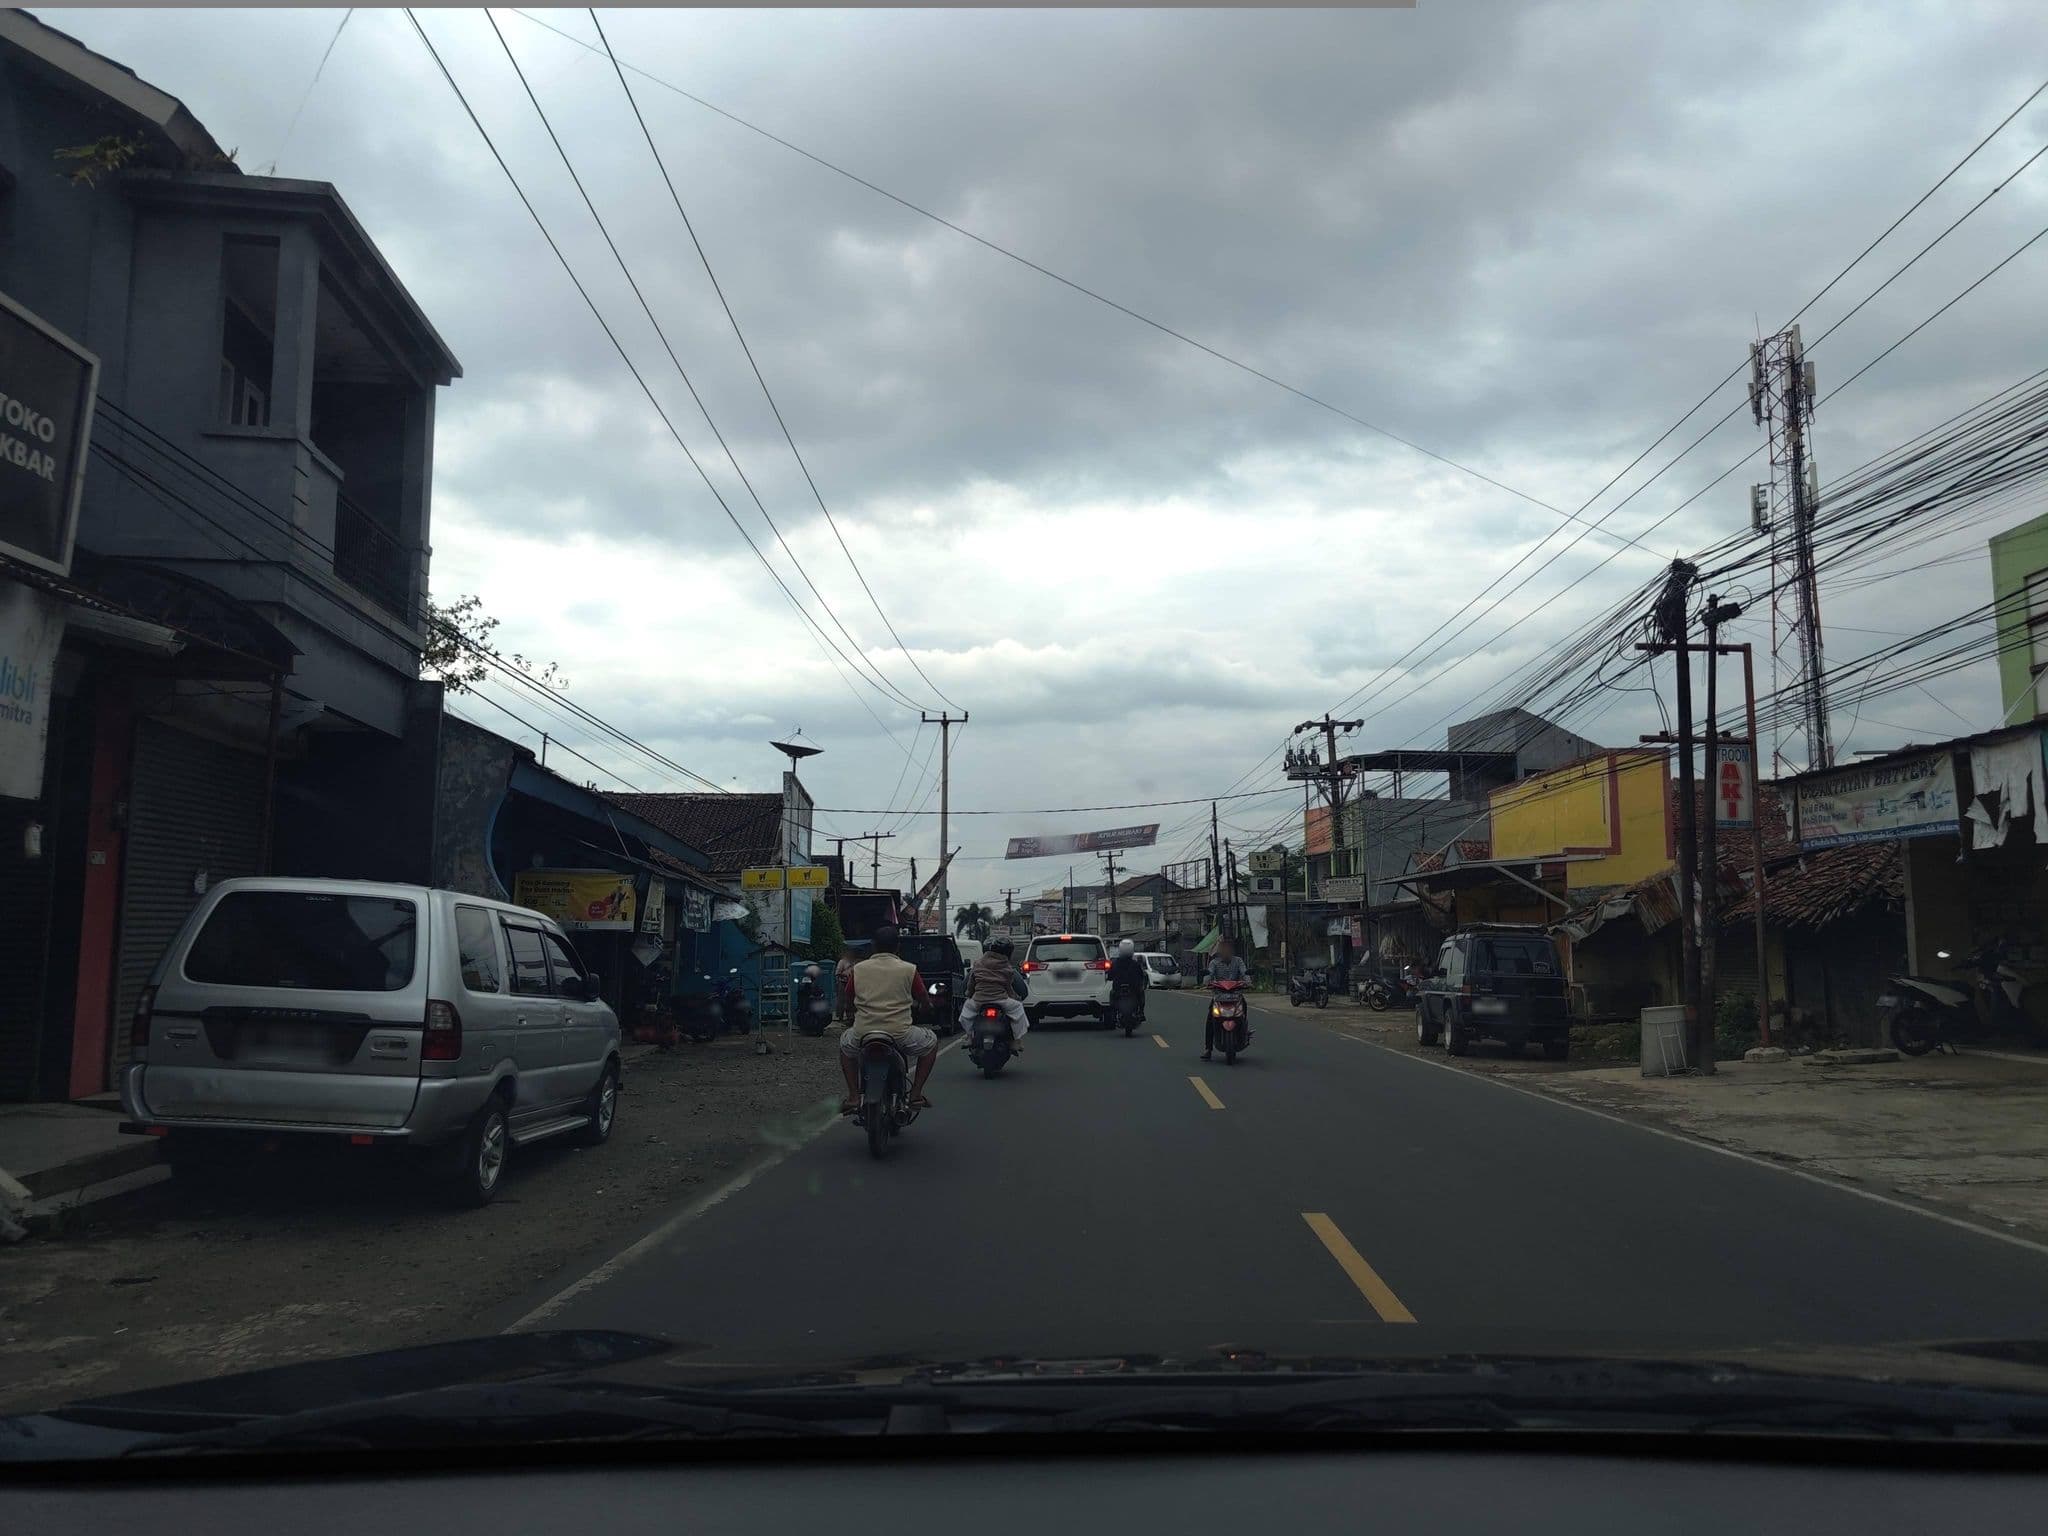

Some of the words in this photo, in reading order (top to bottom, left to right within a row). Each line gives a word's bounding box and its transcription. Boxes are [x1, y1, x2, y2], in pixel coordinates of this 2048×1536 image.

[0, 432, 56, 482] KBAR
[0, 656, 37, 704] libli
[1720, 762, 1745, 820] AKI
